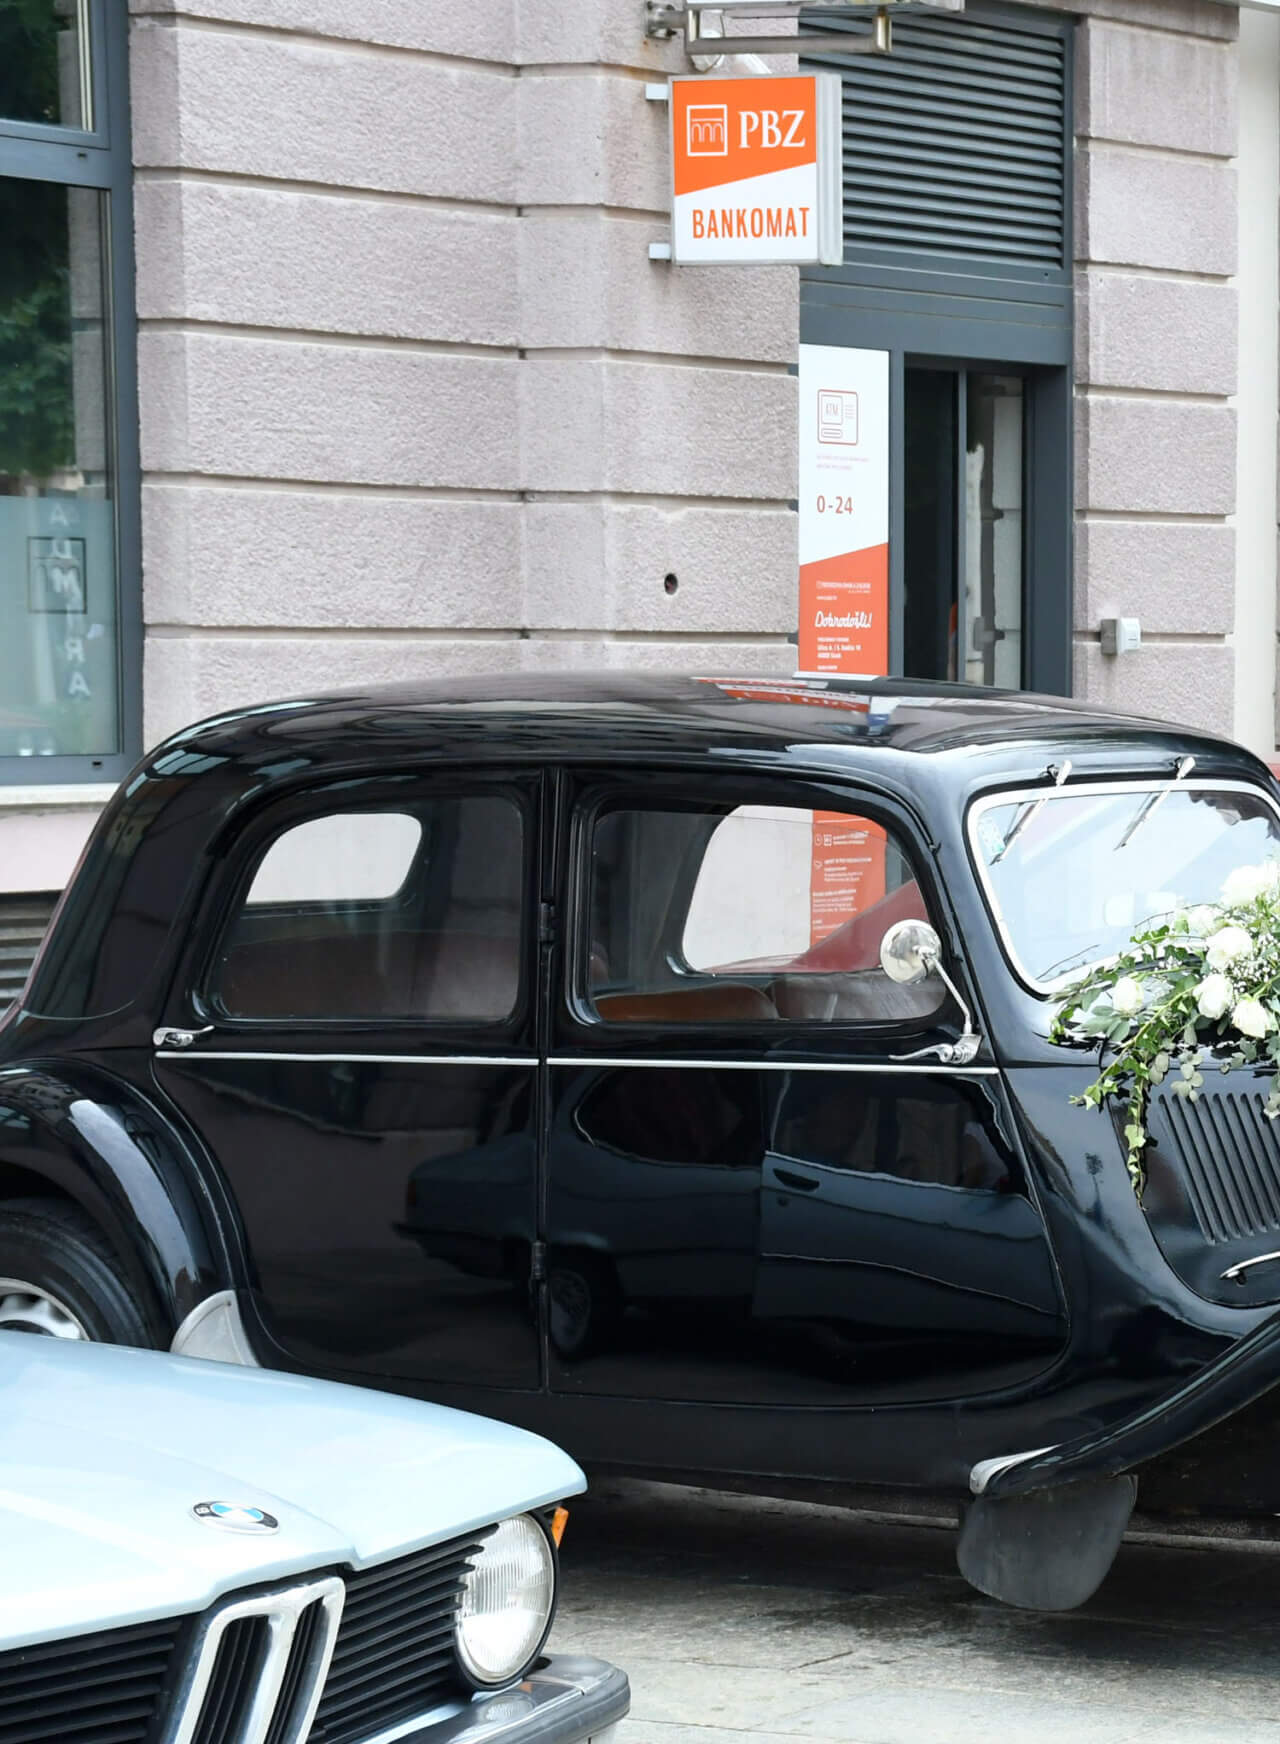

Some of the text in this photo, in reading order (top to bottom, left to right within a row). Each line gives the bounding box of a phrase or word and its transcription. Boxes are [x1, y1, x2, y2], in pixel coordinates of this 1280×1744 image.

[738, 109, 807, 149] PBZ
[692, 207, 810, 239] BANKOMAT
[814, 610, 872, 629] Dobrodošli!
